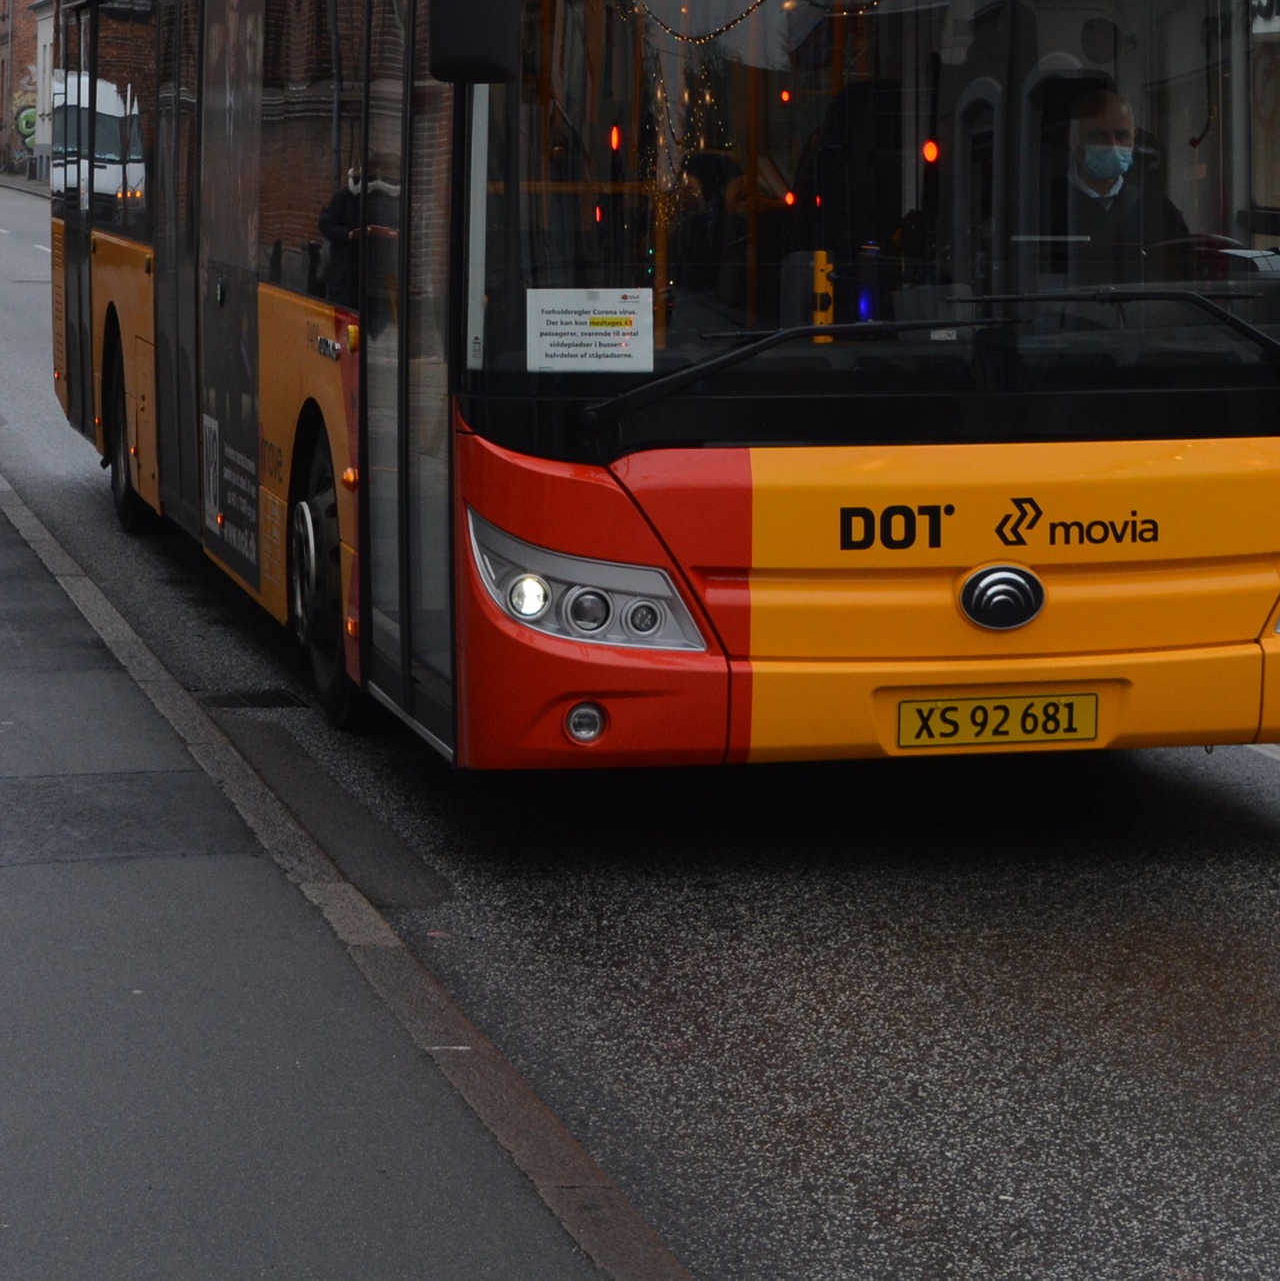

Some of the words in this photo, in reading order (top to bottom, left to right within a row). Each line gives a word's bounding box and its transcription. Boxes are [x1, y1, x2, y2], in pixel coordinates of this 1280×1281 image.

[541, 308, 591, 316] Forholdsregler
[590, 319, 622, 328] medtages
[540, 330, 578, 338] passagerer,
[549, 341, 592, 349] siddepladser
[545, 351, 578, 359] halvdelen
[589, 351, 633, 360] ståpladserne.
[840, 504, 956, 551] DOT
[1049, 510, 1159, 546] movia
[914, 706, 960, 739] XS
[970, 704, 1010, 738] 92
[1021, 701, 1078, 735] 681
